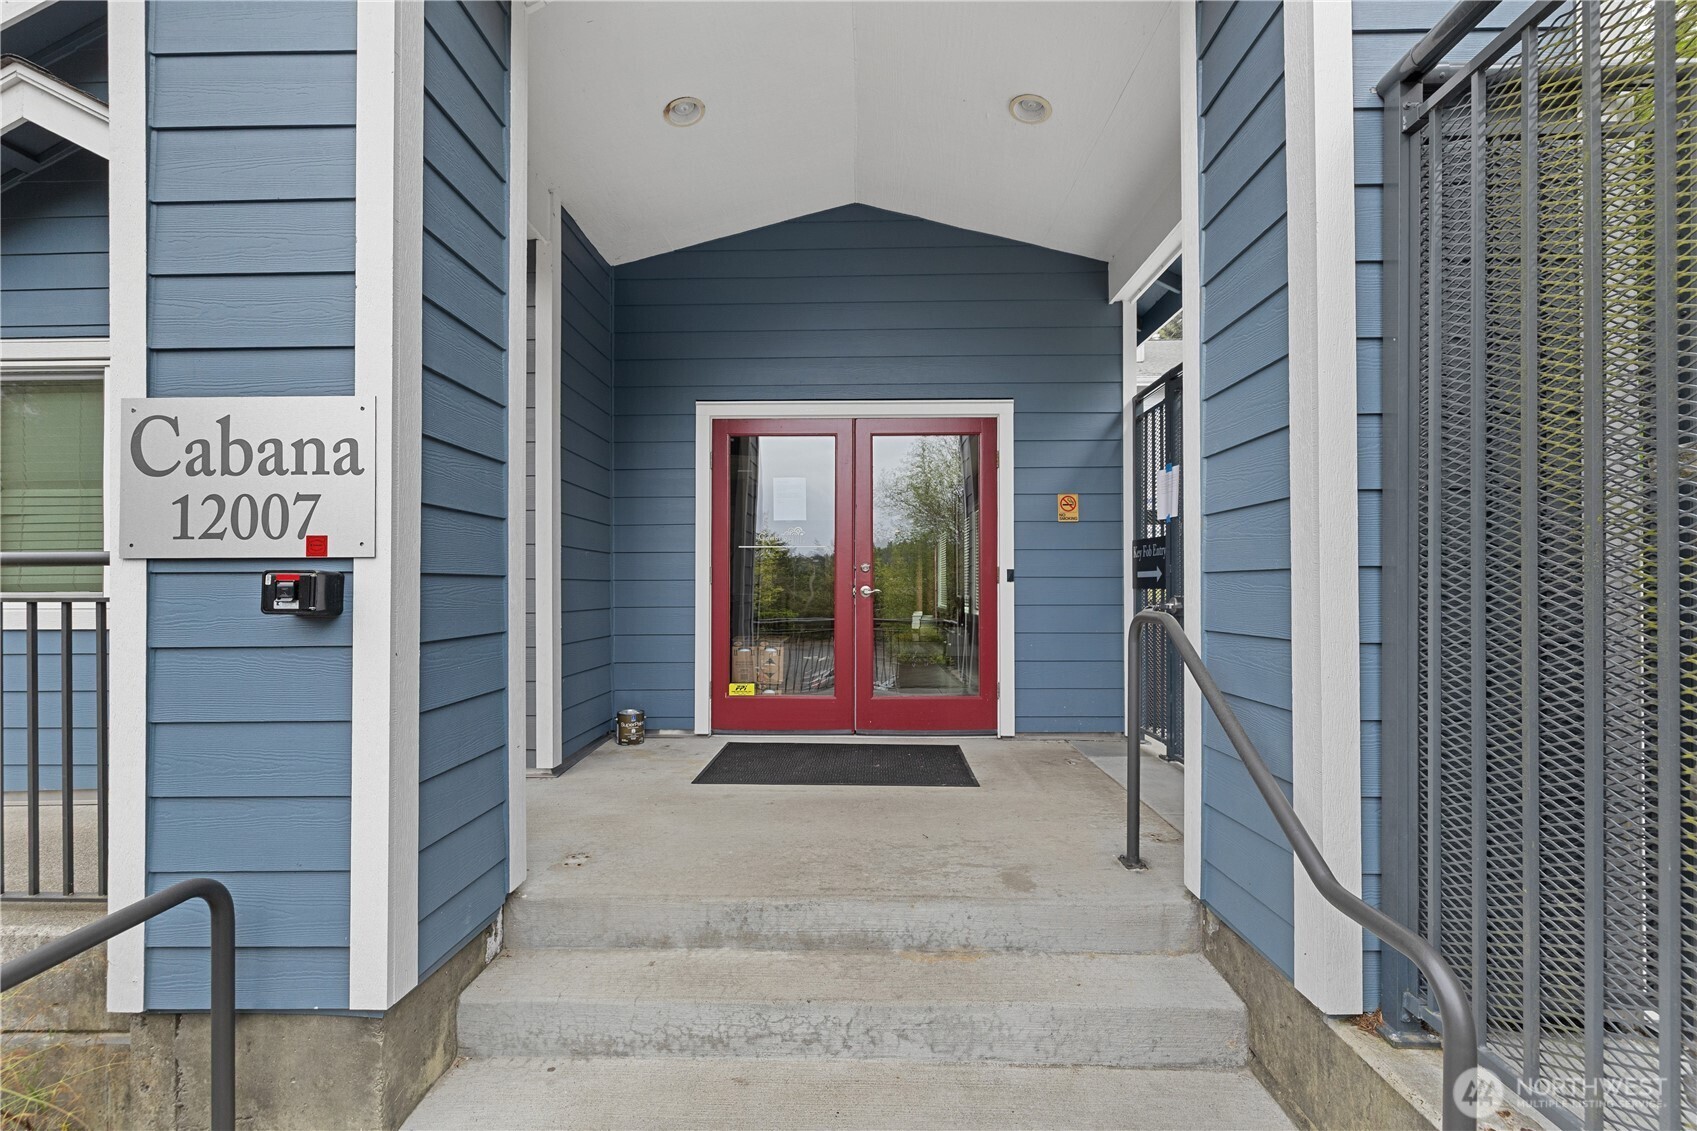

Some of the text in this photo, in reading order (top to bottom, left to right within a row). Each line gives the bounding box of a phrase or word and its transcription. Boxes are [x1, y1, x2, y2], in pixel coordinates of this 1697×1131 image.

[130, 414, 365, 477] Cabana
[171, 492, 322, 541] 12007
[1133, 543, 1166, 561] Key Fob Entry
